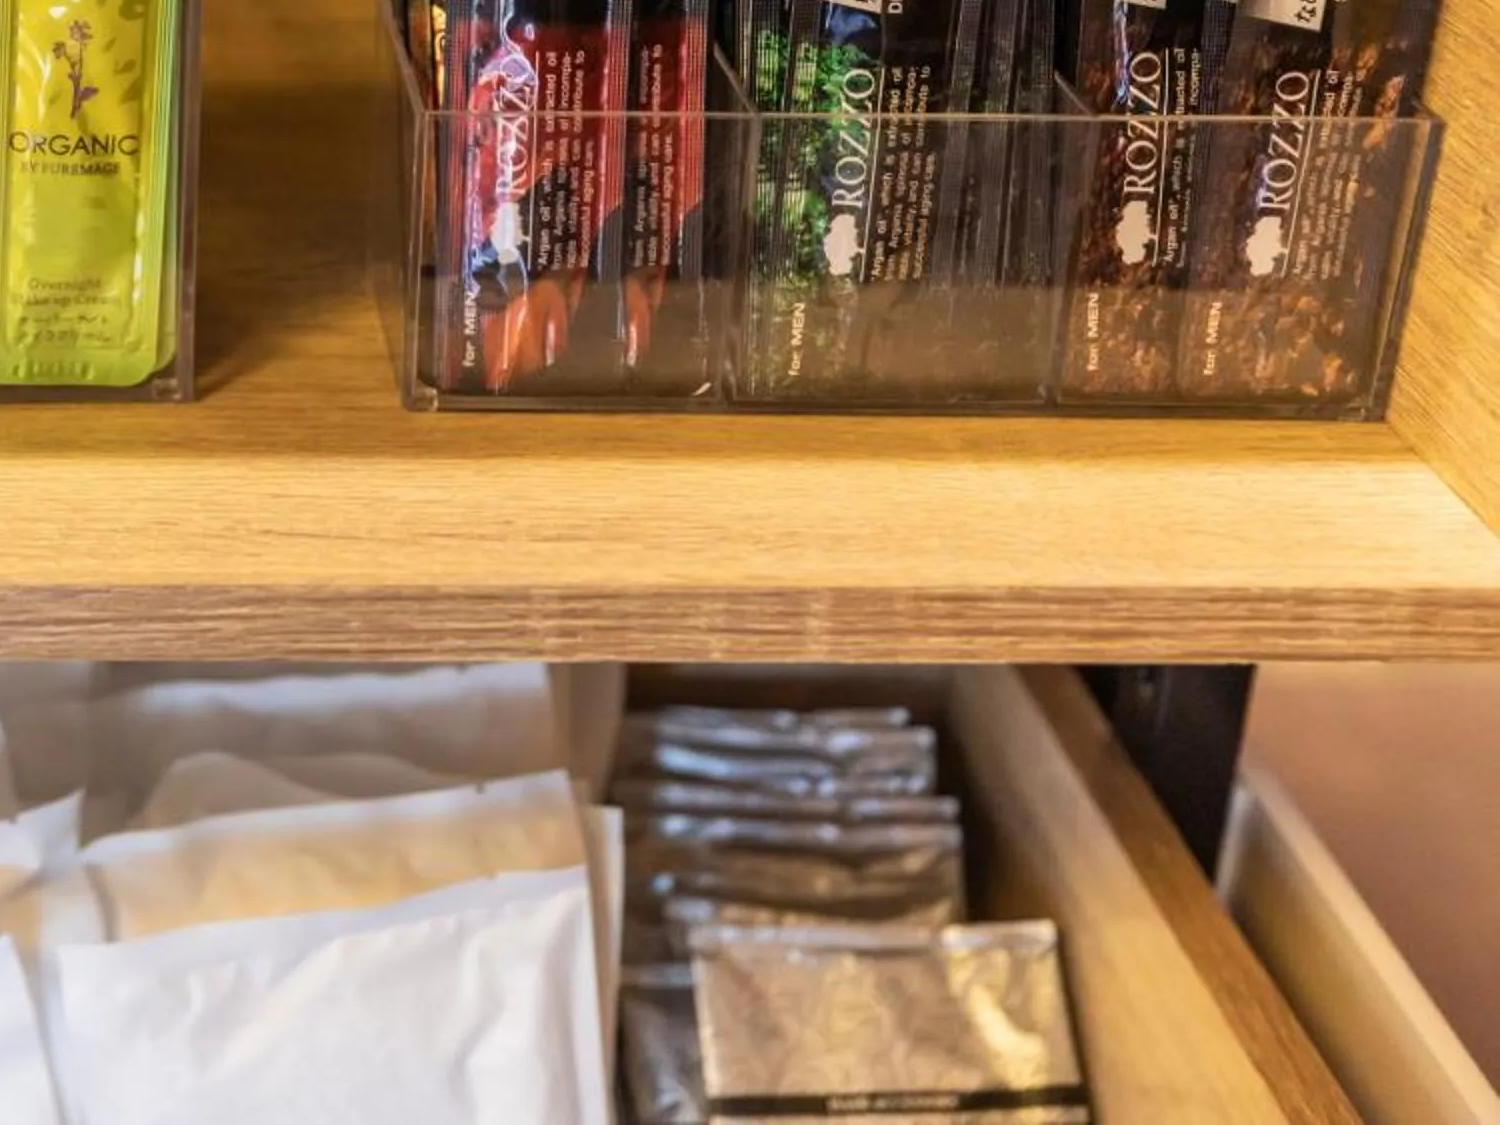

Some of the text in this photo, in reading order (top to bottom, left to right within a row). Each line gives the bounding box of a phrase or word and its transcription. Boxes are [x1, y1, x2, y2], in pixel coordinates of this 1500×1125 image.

[9, 130, 140, 156] ORGANIC
[832, 68, 875, 209] ROZZO
[1124, 51, 1162, 196] ROZZO
[1259, 71, 1309, 212] ROZZO
[463, 290, 478, 367] for MEN
[787, 302, 806, 376] for MEN
[1086, 291, 1100, 338] MEN
[1205, 302, 1223, 345] MEN
